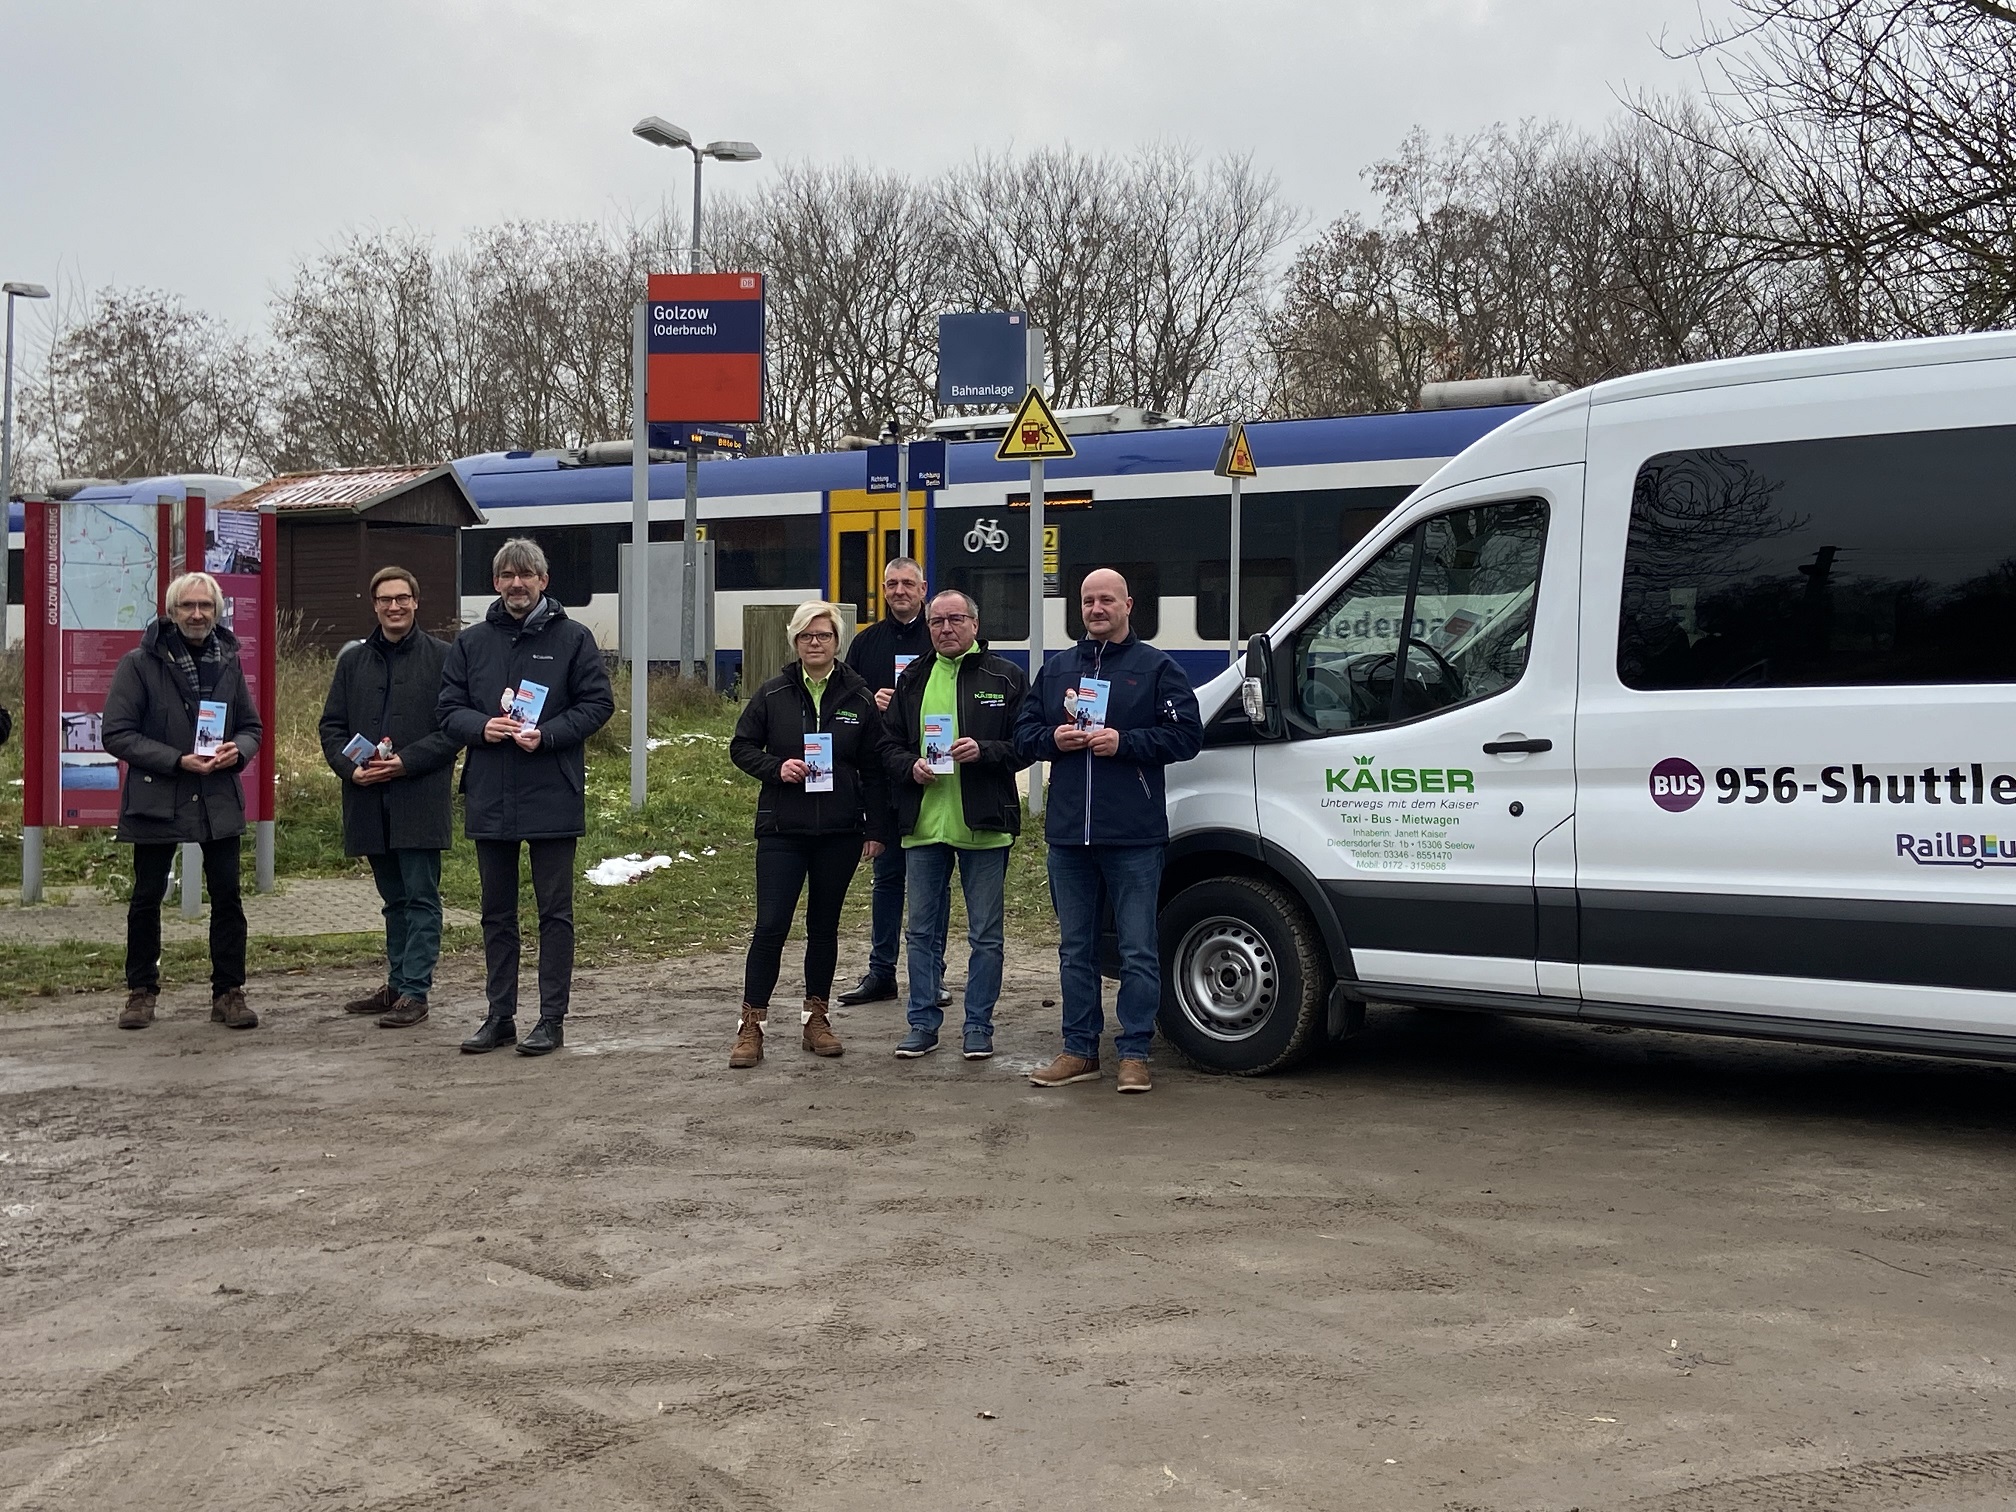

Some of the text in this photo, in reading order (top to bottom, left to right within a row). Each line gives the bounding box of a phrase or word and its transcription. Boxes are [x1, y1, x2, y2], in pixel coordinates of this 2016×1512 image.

[653, 305, 709, 320] Golzow
[653, 323, 717, 336] (Oderbruch)
[951, 384, 1014, 397] Bahnanlage
[1044, 531, 1054, 548] 2
[48, 508, 58, 625] GOLZOW UND UMGEBUNG
[1325, 768, 1475, 794] KAISER
[1653, 774, 1702, 796] BUS
[1715, 763, 2016, 805] 956-Shuttle
[1320, 798, 1480, 810] Unterwegs mit dem Kaiser
[1340, 814, 1362, 824] Taxi
[1371, 814, 1392, 824] Bus
[1402, 814, 1460, 827] Mietwagen
[1353, 829, 1447, 838] Inhaberin: Janett Kaiser
[1327, 838, 1381, 848] Diedersdorfer
[1383, 840, 1397, 848] Str.
[1399, 840, 1409, 848] 1b
[1417, 840, 1442, 849] 15306
[1444, 841, 1475, 850] Seelow
[1351, 849, 1382, 858] Telefon:
[1383, 850, 1409, 859] 03346
[1416, 851, 1453, 860] 8551470
[1356, 860, 1379, 869] Mobil:
[1382, 861, 1402, 869] 0172
[1410, 861, 1447, 870] 3159658
